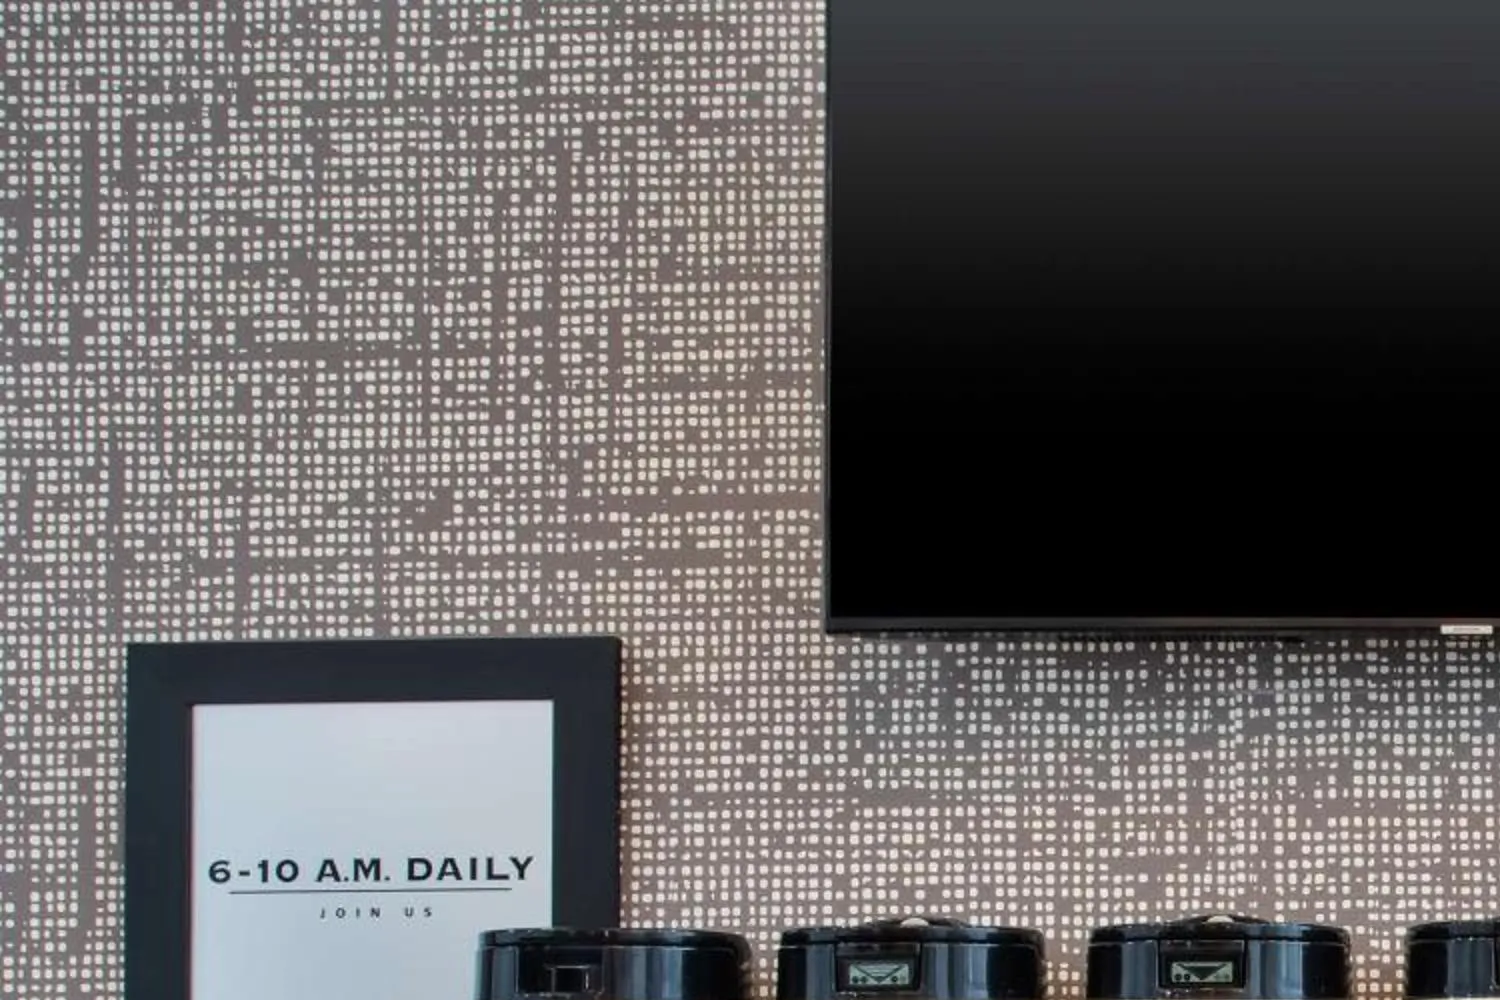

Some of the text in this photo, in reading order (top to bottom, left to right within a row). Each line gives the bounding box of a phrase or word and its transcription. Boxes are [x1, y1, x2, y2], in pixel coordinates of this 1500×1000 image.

[208, 856, 534, 884] 6-10 A.M. DAILY
[319, 906, 433, 919] JOIN US
